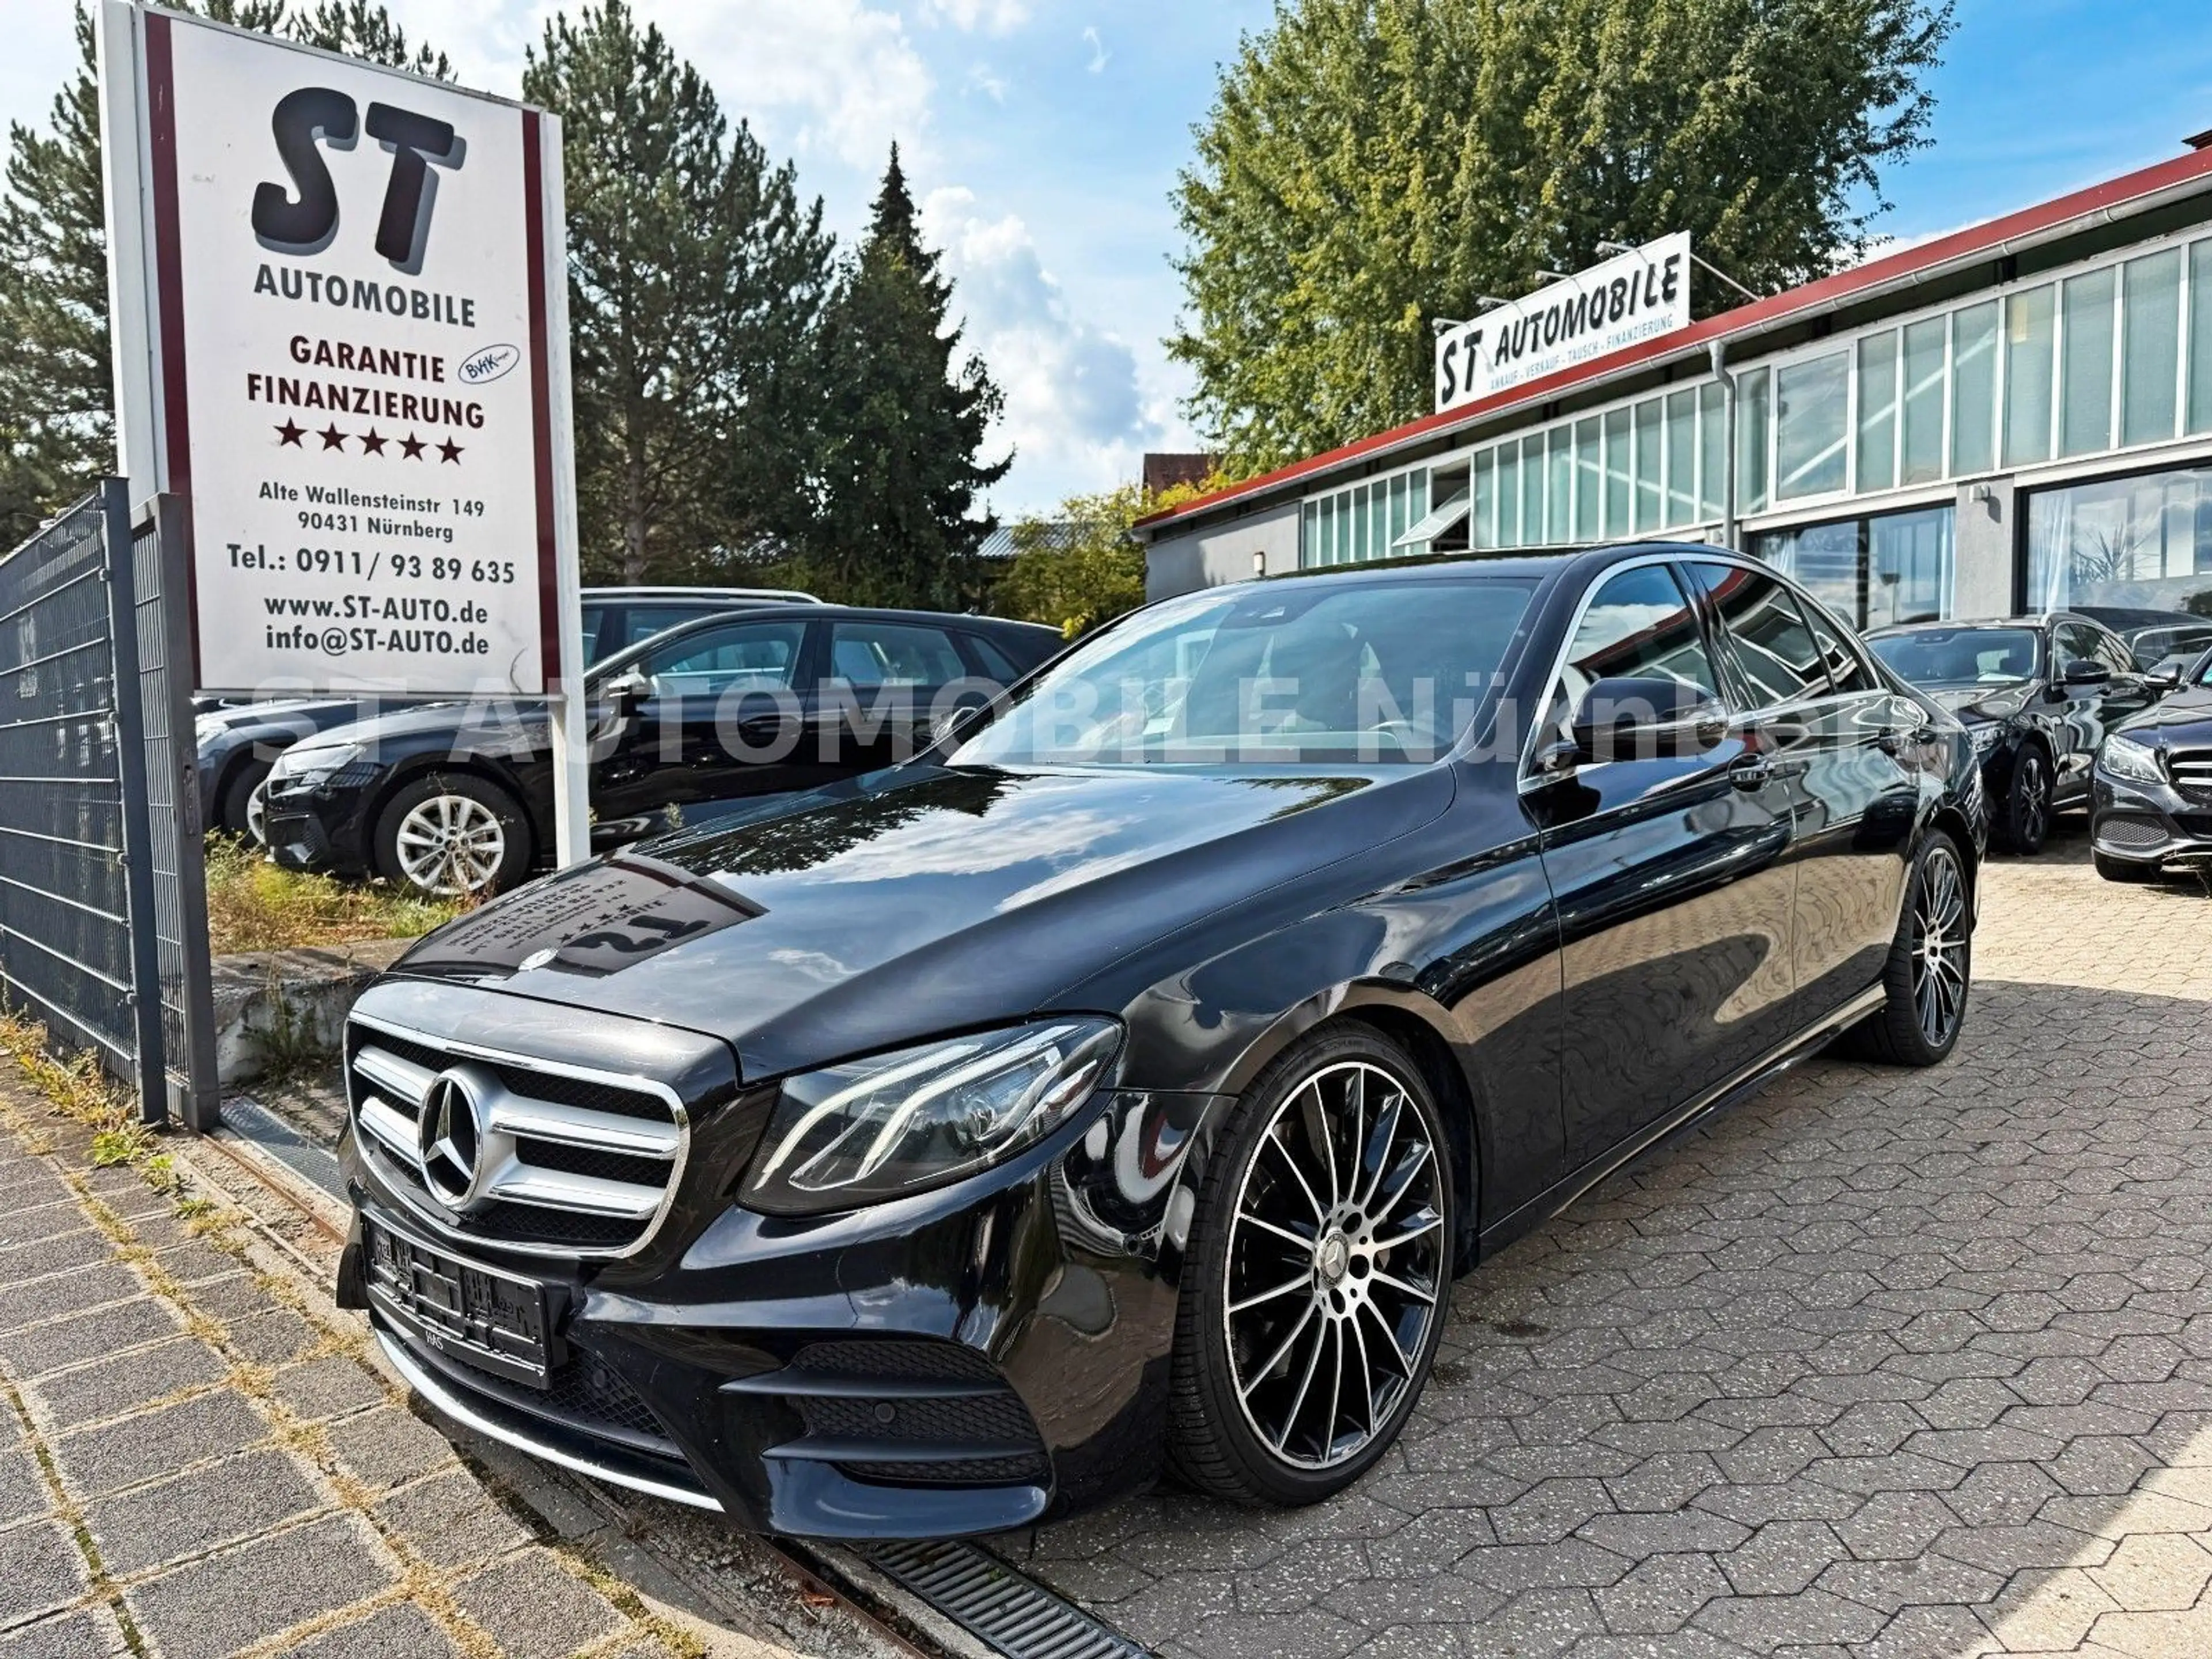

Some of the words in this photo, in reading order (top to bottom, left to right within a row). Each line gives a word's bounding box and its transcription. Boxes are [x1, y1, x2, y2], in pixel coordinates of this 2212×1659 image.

[252, 86, 467, 276] ST
[253, 263, 476, 328] AUTOMOBILE
[1441, 329, 1483, 404] ST
[1495, 252, 1681, 366] AUTOMOBILE
[1568, 342, 1598, 362] TAUSCH
[1607, 316, 1673, 347] FINANZIERUNG
[289, 335, 445, 383] GARANTIE
[247, 373, 485, 429] FINANZIERUNG
[259, 482, 298, 501] Alte
[305, 485, 441, 514] Wallensteinstr
[452, 499, 485, 517] 149
[298, 512, 358, 533] 90431
[368, 516, 454, 543] Nürnberg
[227, 543, 286, 571] Tel.:
[391, 554, 422, 578] 93
[433, 558, 461, 581] 89
[471, 560, 515, 584] 635
[264, 594, 488, 624] www.ST-AUTO.de
[266, 625, 490, 656] info@ST-AUTO.de
